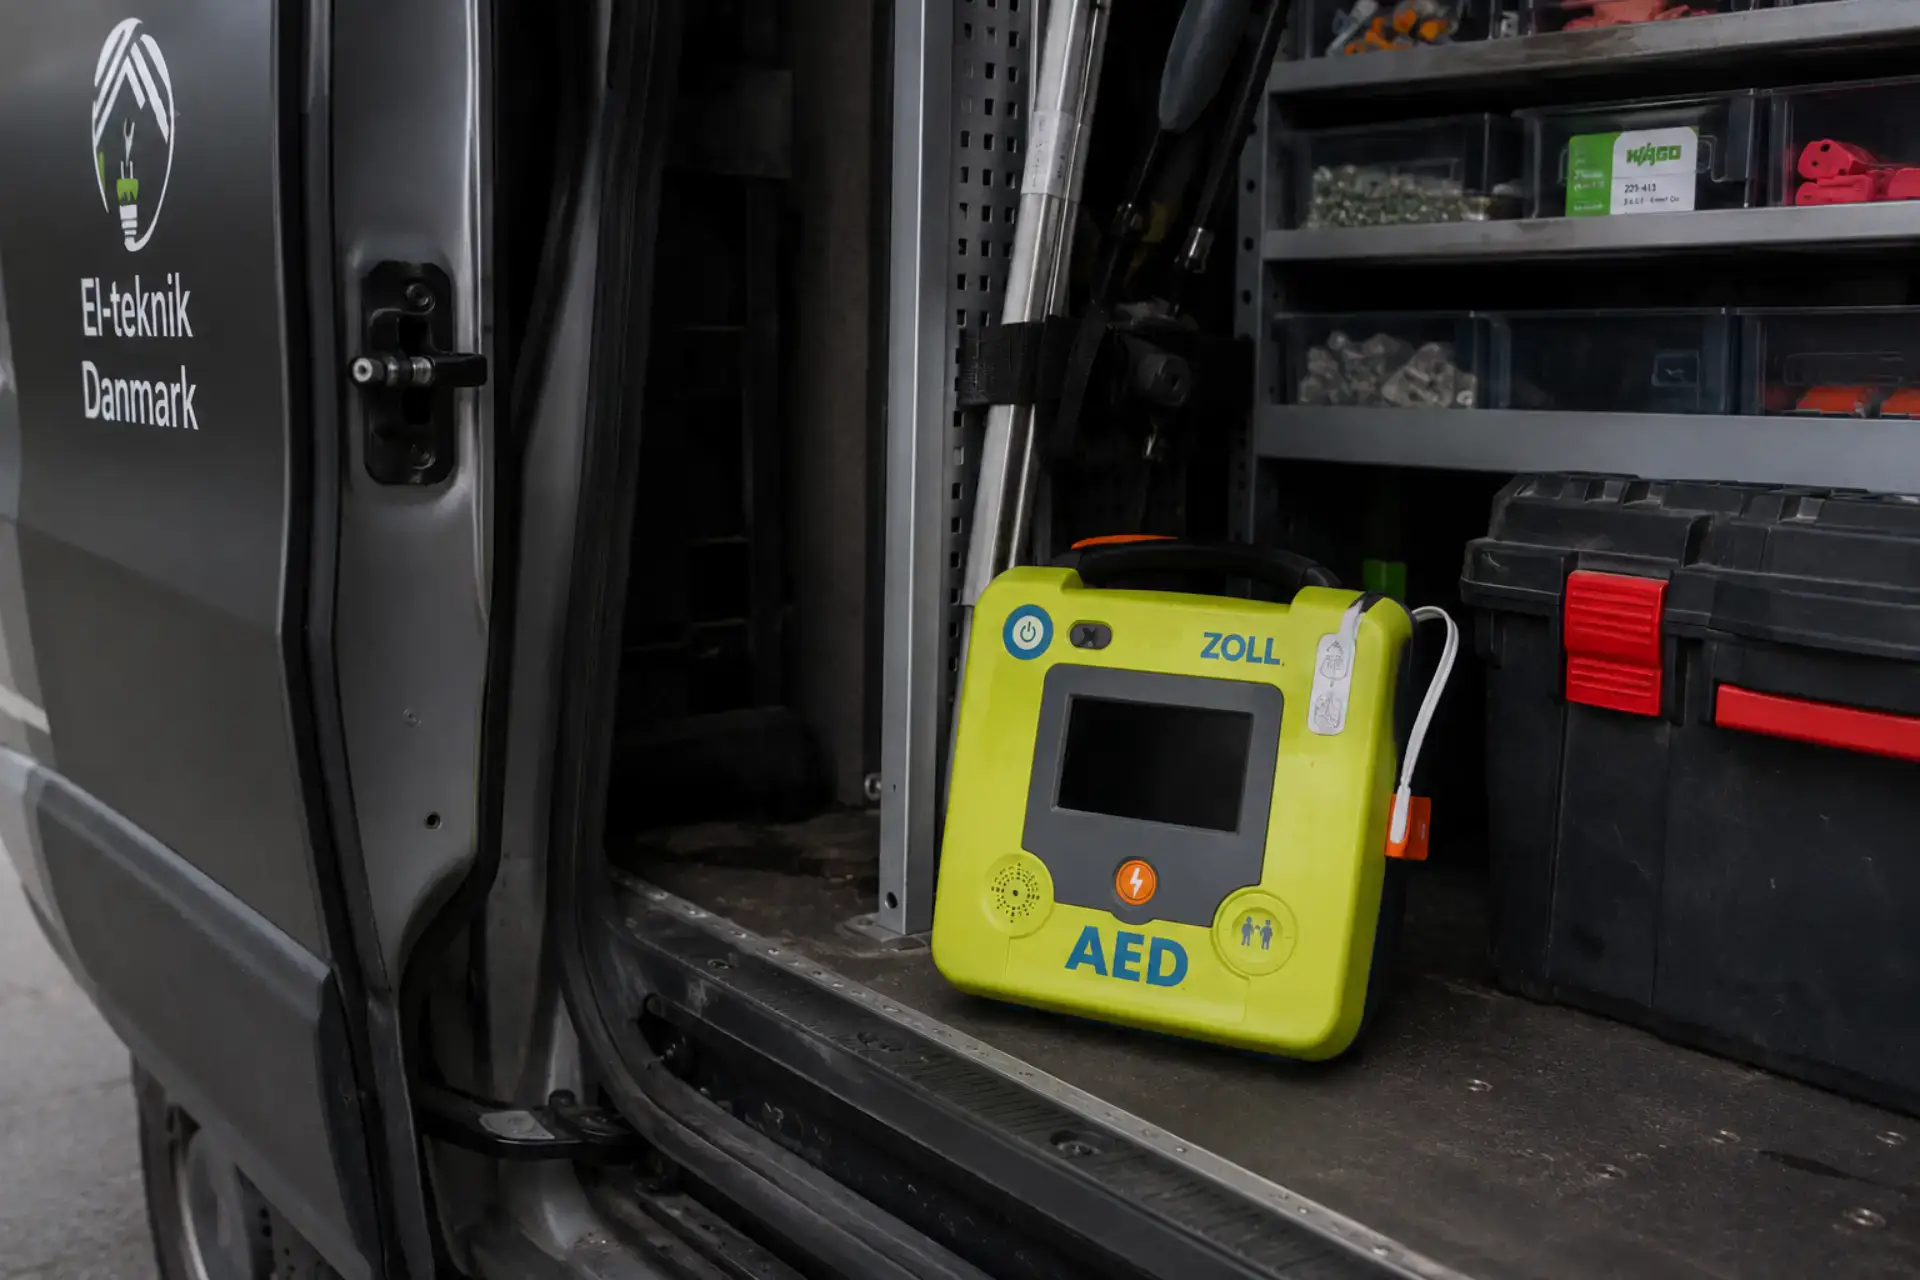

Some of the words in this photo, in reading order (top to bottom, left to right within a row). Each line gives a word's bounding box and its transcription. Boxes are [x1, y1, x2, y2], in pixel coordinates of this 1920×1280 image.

[1626, 143, 1682, 166] WAGO
[81, 272, 194, 338] El-teknik
[81, 360, 199, 431] Danmark
[1200, 631, 1281, 666] ZOLL
[1064, 925, 1189, 987] AED
